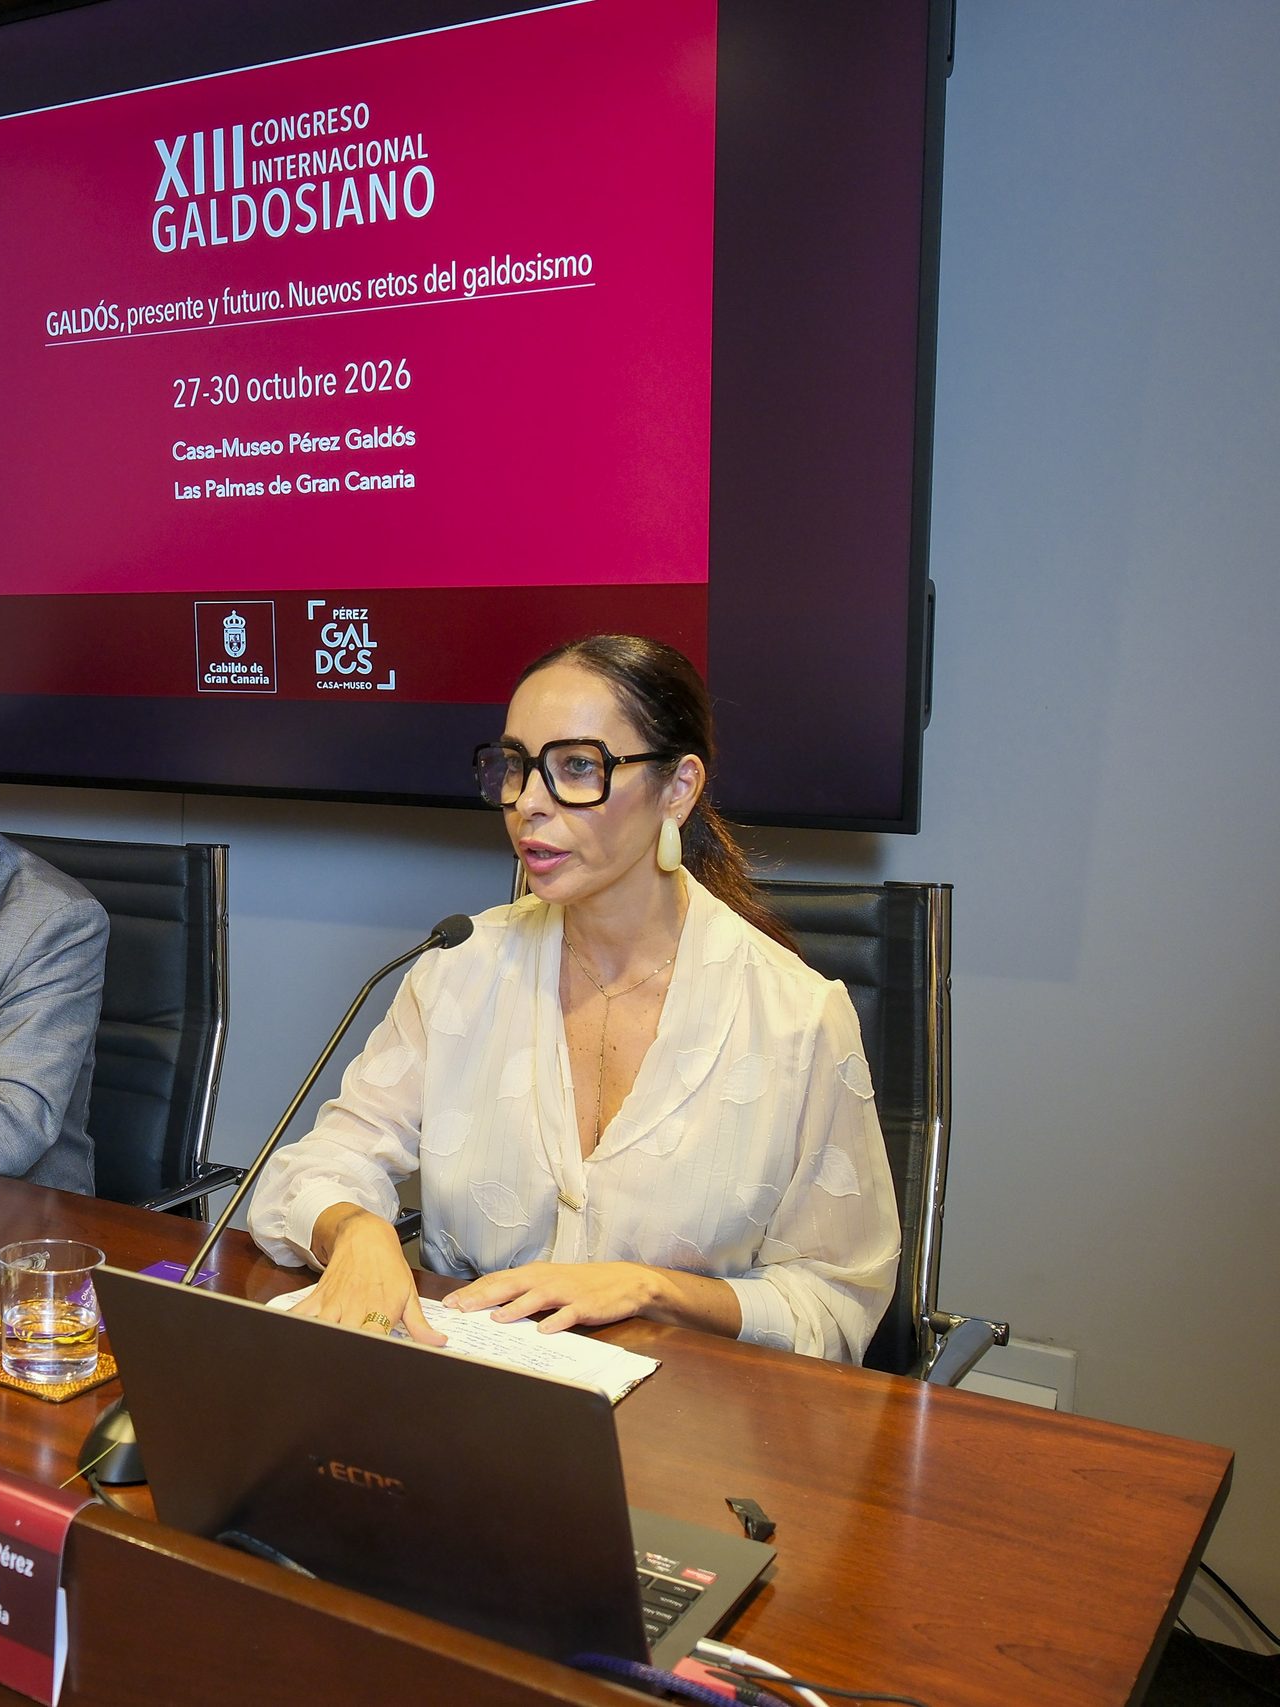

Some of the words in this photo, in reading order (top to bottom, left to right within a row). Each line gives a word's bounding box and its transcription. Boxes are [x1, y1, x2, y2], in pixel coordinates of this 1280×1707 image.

[154, 124, 245, 202] XIII
[250, 102, 370, 147] CONGRESO
[252, 133, 429, 186] INTERNACIONAL
[151, 165, 436, 253] GALDOSIANO
[126, 296, 204, 334] presente
[207, 298, 219, 324] y
[222, 287, 285, 315] futuro.
[288, 280, 362, 308] Nuevos
[368, 273, 418, 299] retos
[424, 260, 456, 293] del
[463, 253, 593, 297] galdosismo
[173, 374, 240, 408] 27-30
[246, 366, 337, 402] octubre
[344, 358, 412, 395] 2026
[172, 437, 284, 461] Casa-Museo
[289, 432, 341, 454] Pérez
[345, 425, 416, 450] Galdós
[174, 481, 201, 500] Las
[205, 477, 265, 498] Palmas
[268, 475, 292, 495] de
[296, 474, 340, 494] Gran
[344, 469, 415, 491] Canaria
[332, 606, 368, 620] PÉREZ
[321, 623, 378, 648] GAL
[204, 674, 228, 684] Gran
[230, 674, 270, 685] Canaria
[209, 662, 248, 673] Cabildo
[250, 662, 263, 673] de
[316, 681, 373, 690] CASA-MUSEO
